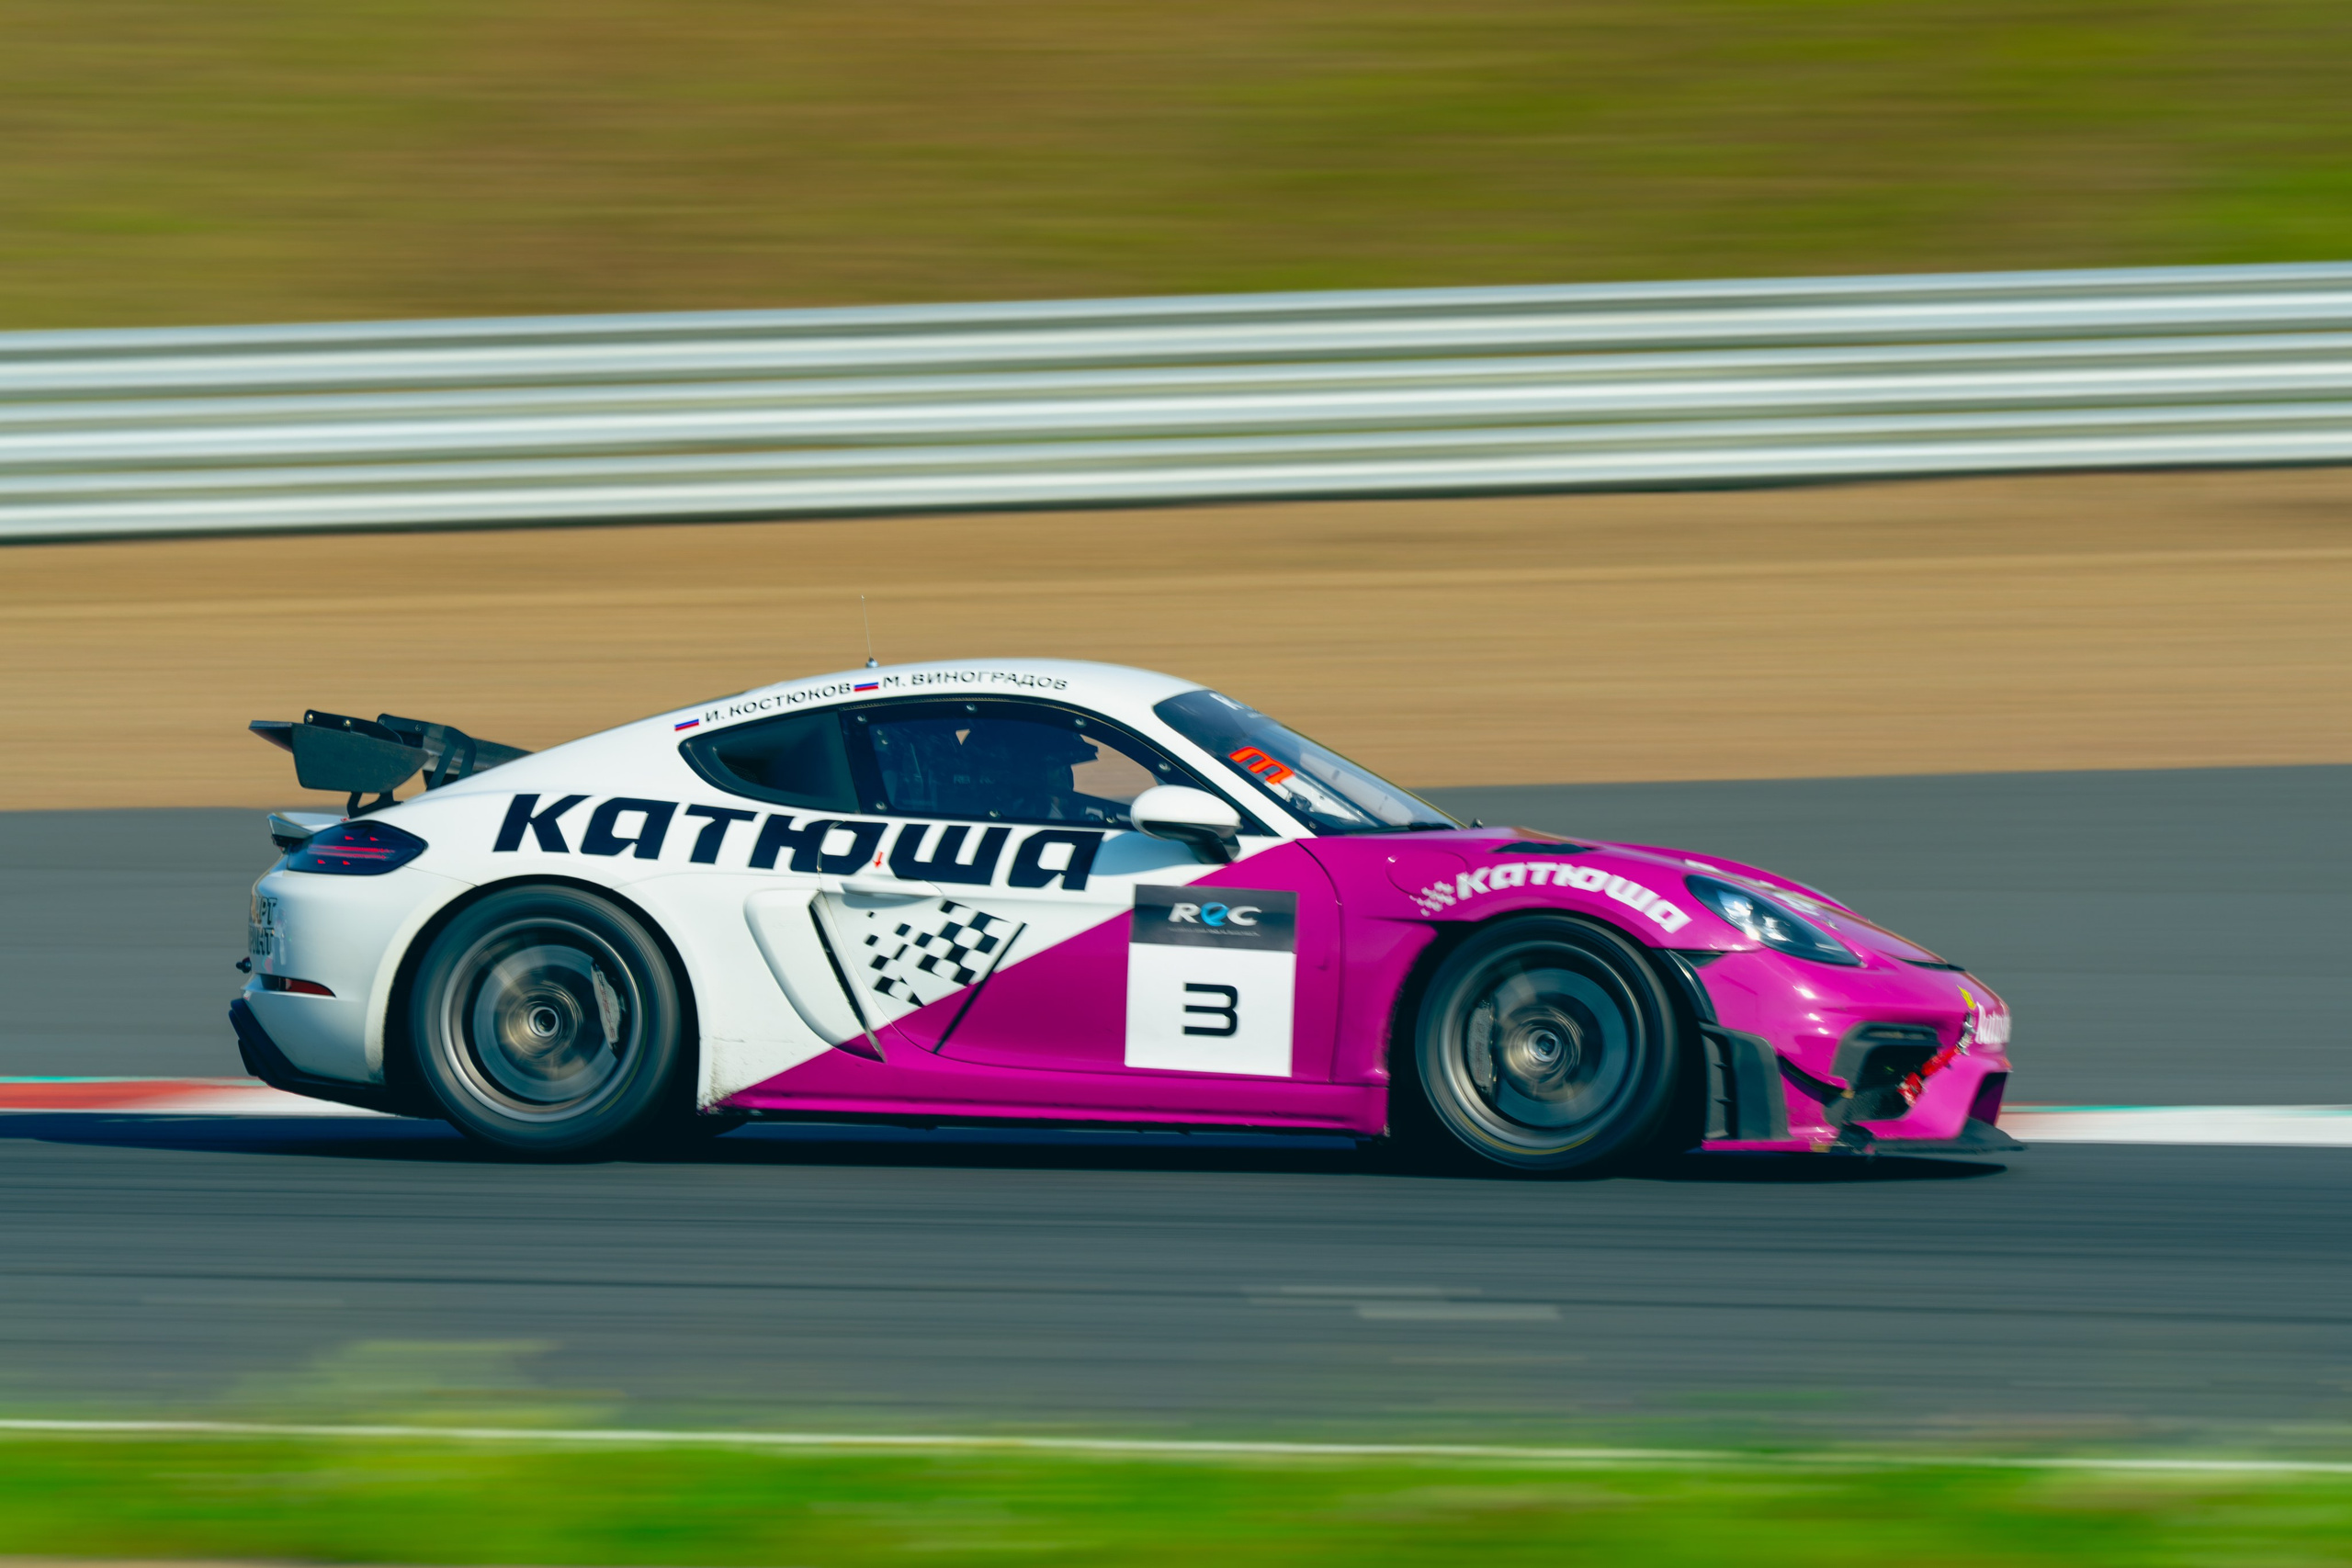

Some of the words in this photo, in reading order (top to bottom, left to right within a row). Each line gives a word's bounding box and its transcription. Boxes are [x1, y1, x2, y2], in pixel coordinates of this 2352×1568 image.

[913, 671, 1069, 691] ВИНОГРАДОВ
[730, 682, 852, 716] КОСТЮКОВ
[1182, 981, 1238, 1037] 3
